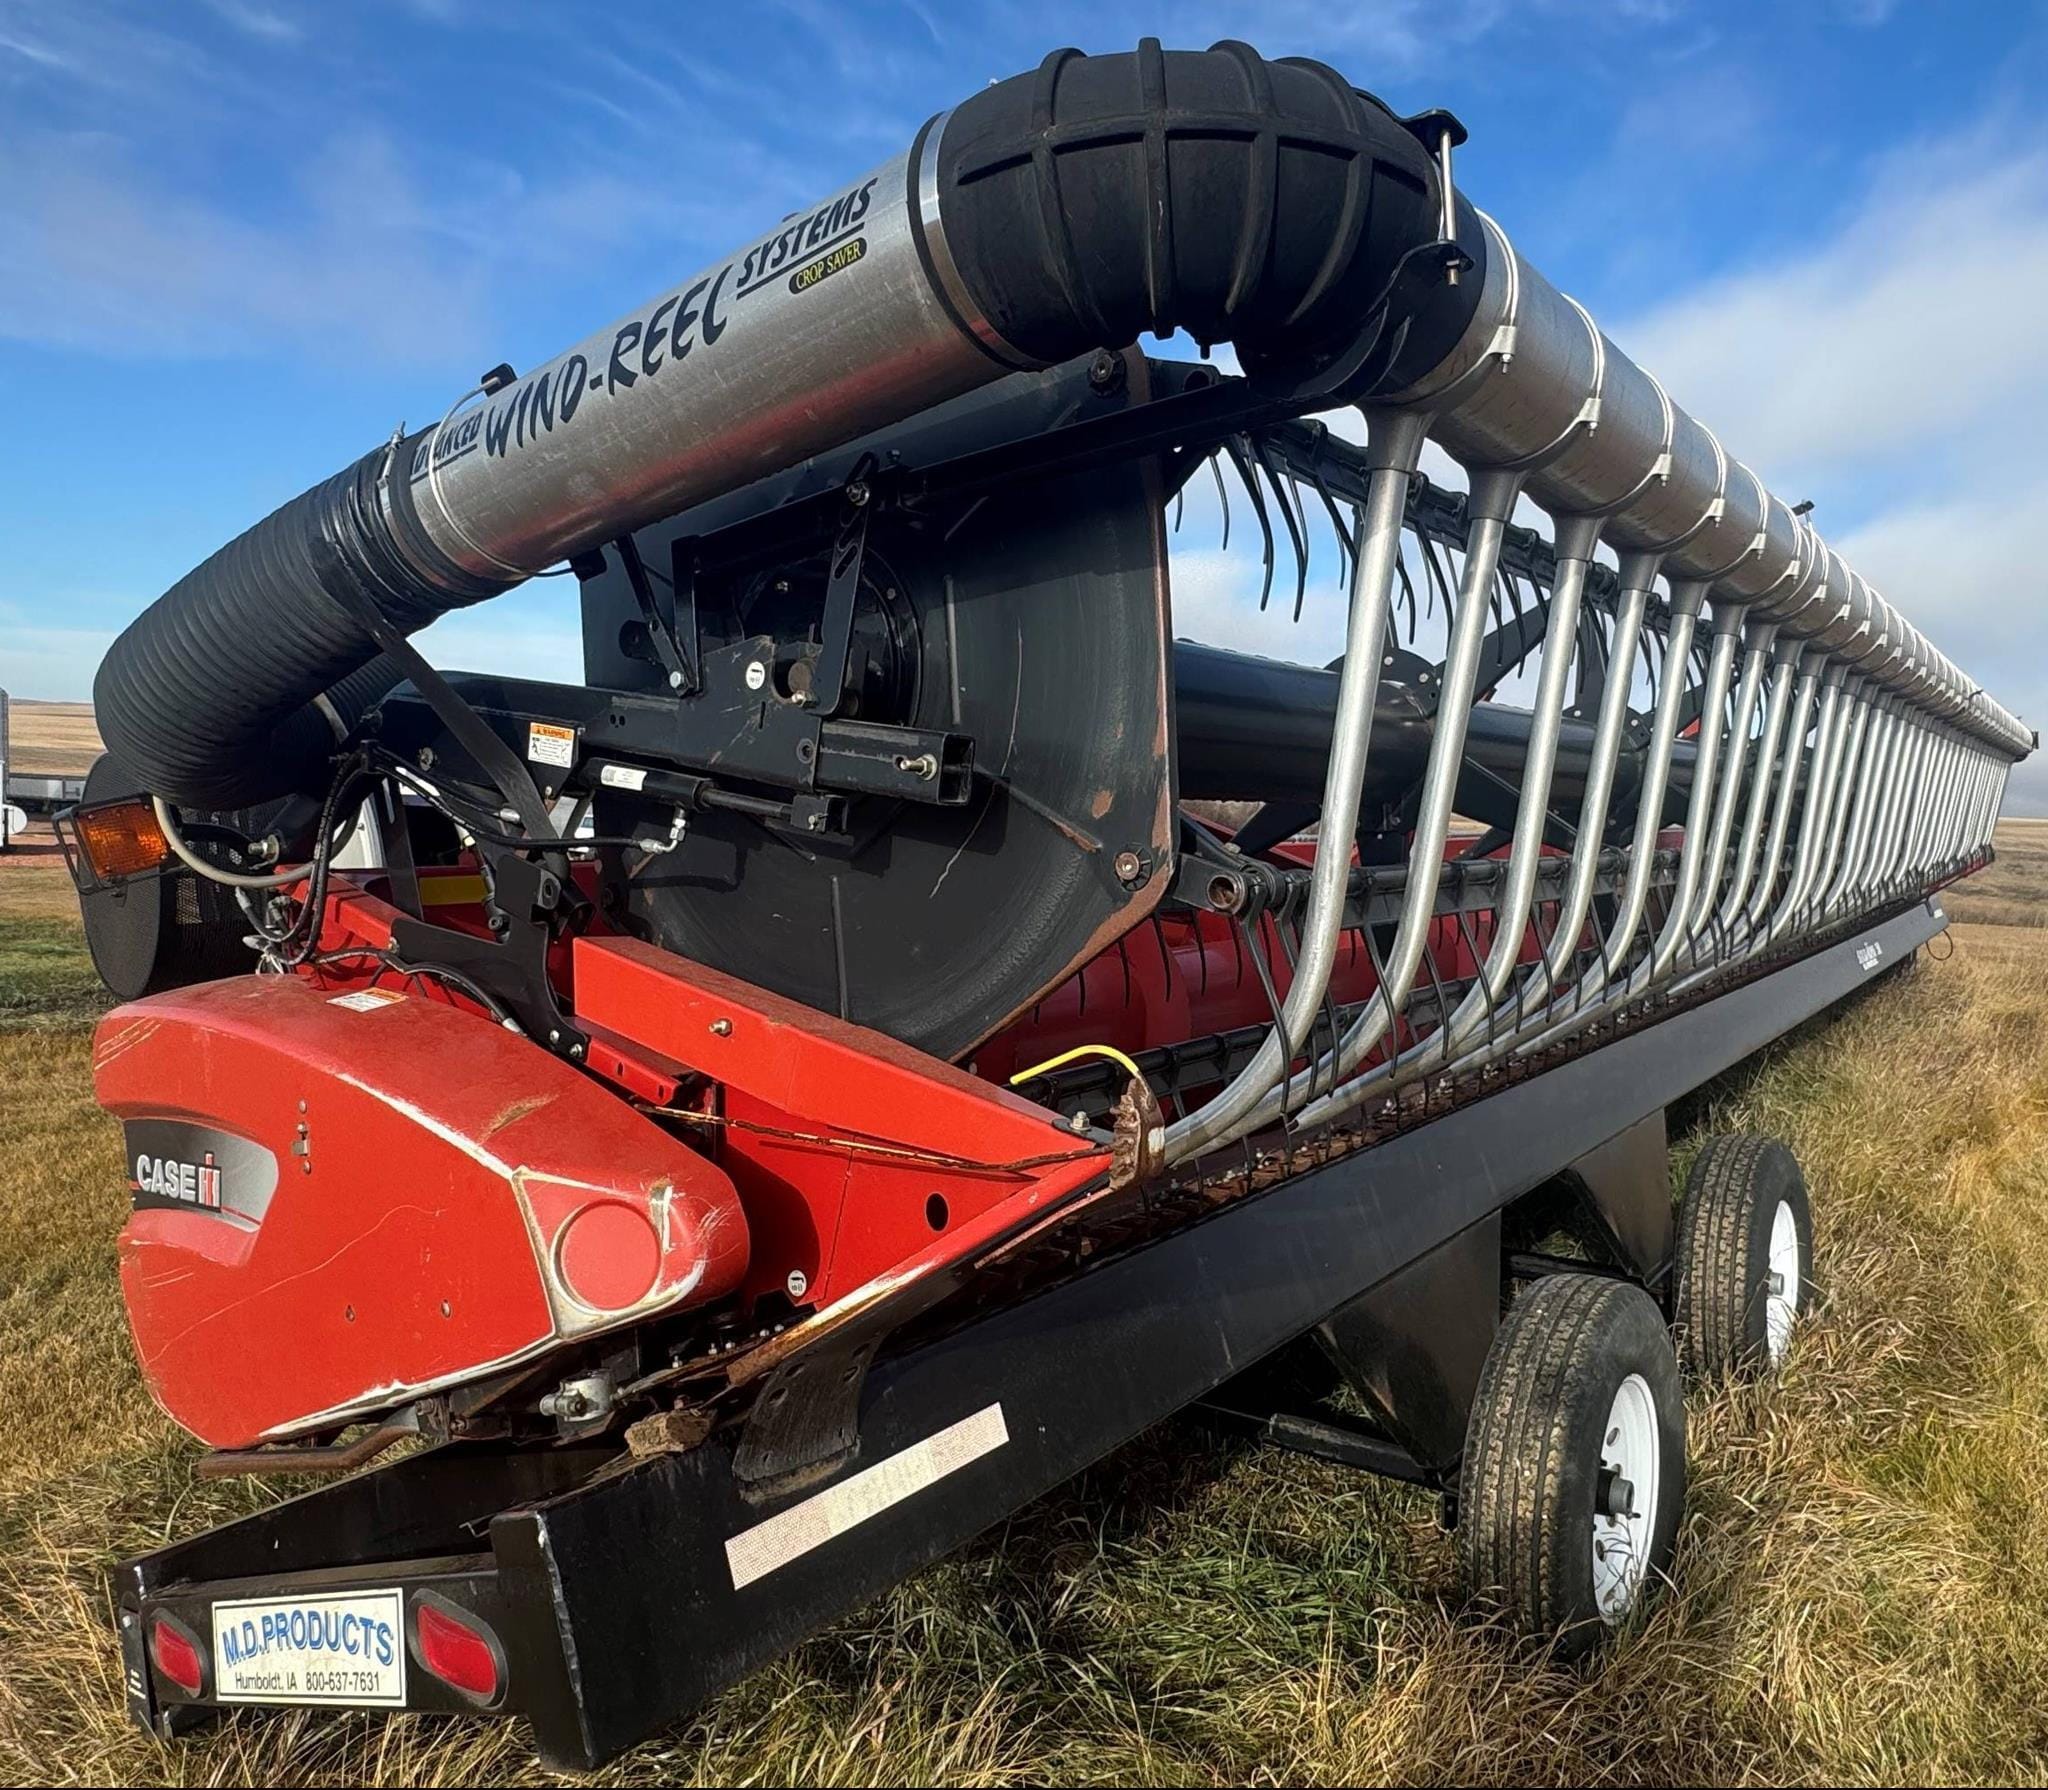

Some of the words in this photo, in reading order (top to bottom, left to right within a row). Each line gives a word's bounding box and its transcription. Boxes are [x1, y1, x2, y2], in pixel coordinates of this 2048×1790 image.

[796, 261, 825, 290] CROP
[827, 241, 862, 273] SAVER
[485, 263, 733, 458] WIND-REEL
[737, 177, 878, 286] SYSTEMS
[137, 1154, 196, 1203] CASE
[235, 1672, 284, 1690] Humboldt,
[286, 1672, 298, 1690] IA
[305, 1672, 380, 1691] 800-637-7631
